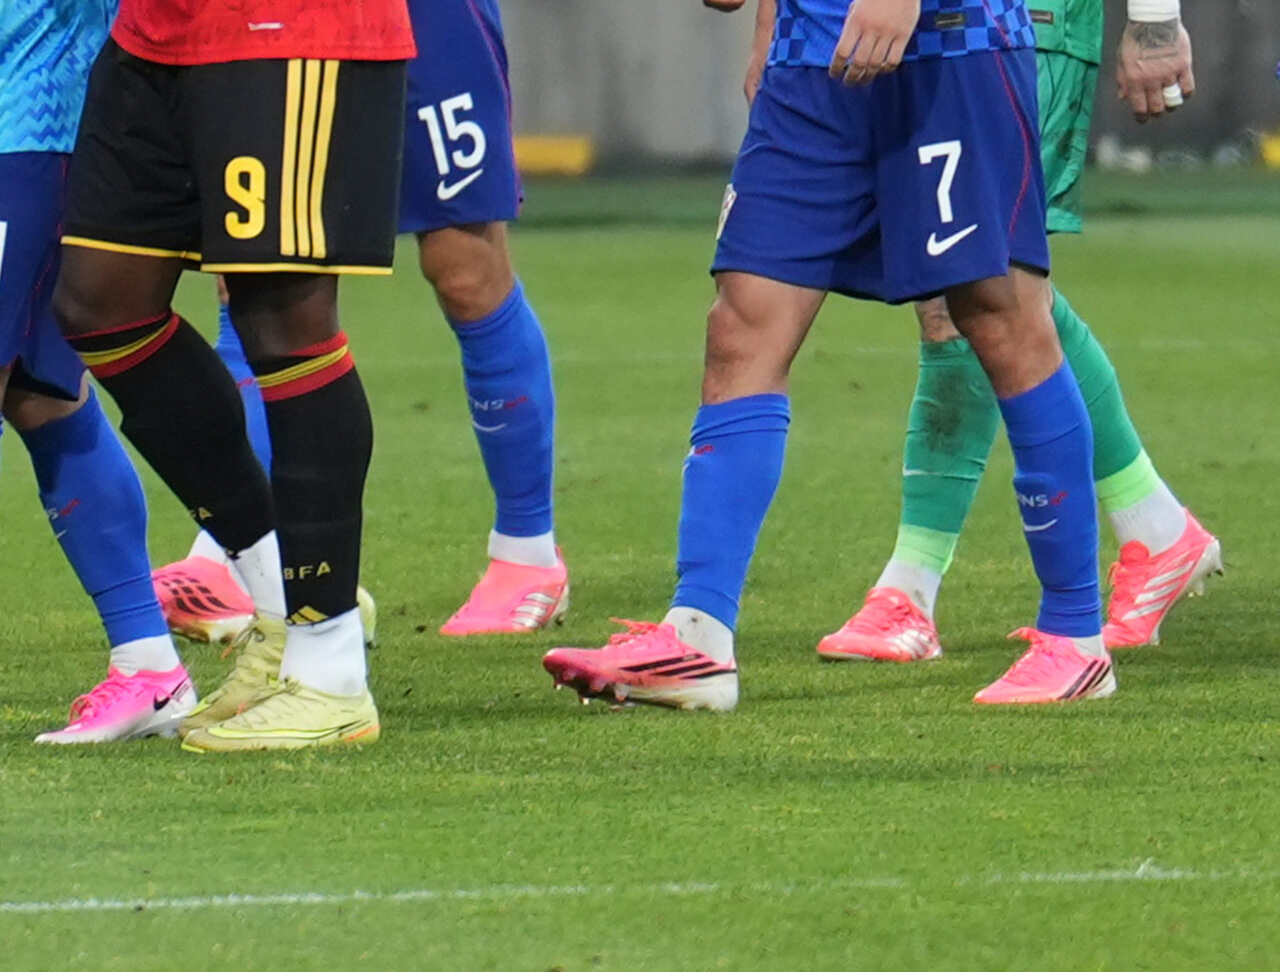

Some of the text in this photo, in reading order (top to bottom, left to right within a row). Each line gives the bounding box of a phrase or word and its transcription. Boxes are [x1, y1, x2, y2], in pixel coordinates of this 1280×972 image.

[417, 92, 487, 176] 15
[224, 155, 266, 240] 9
[918, 139, 962, 223] 7
[283, 561, 331, 580] BFA
